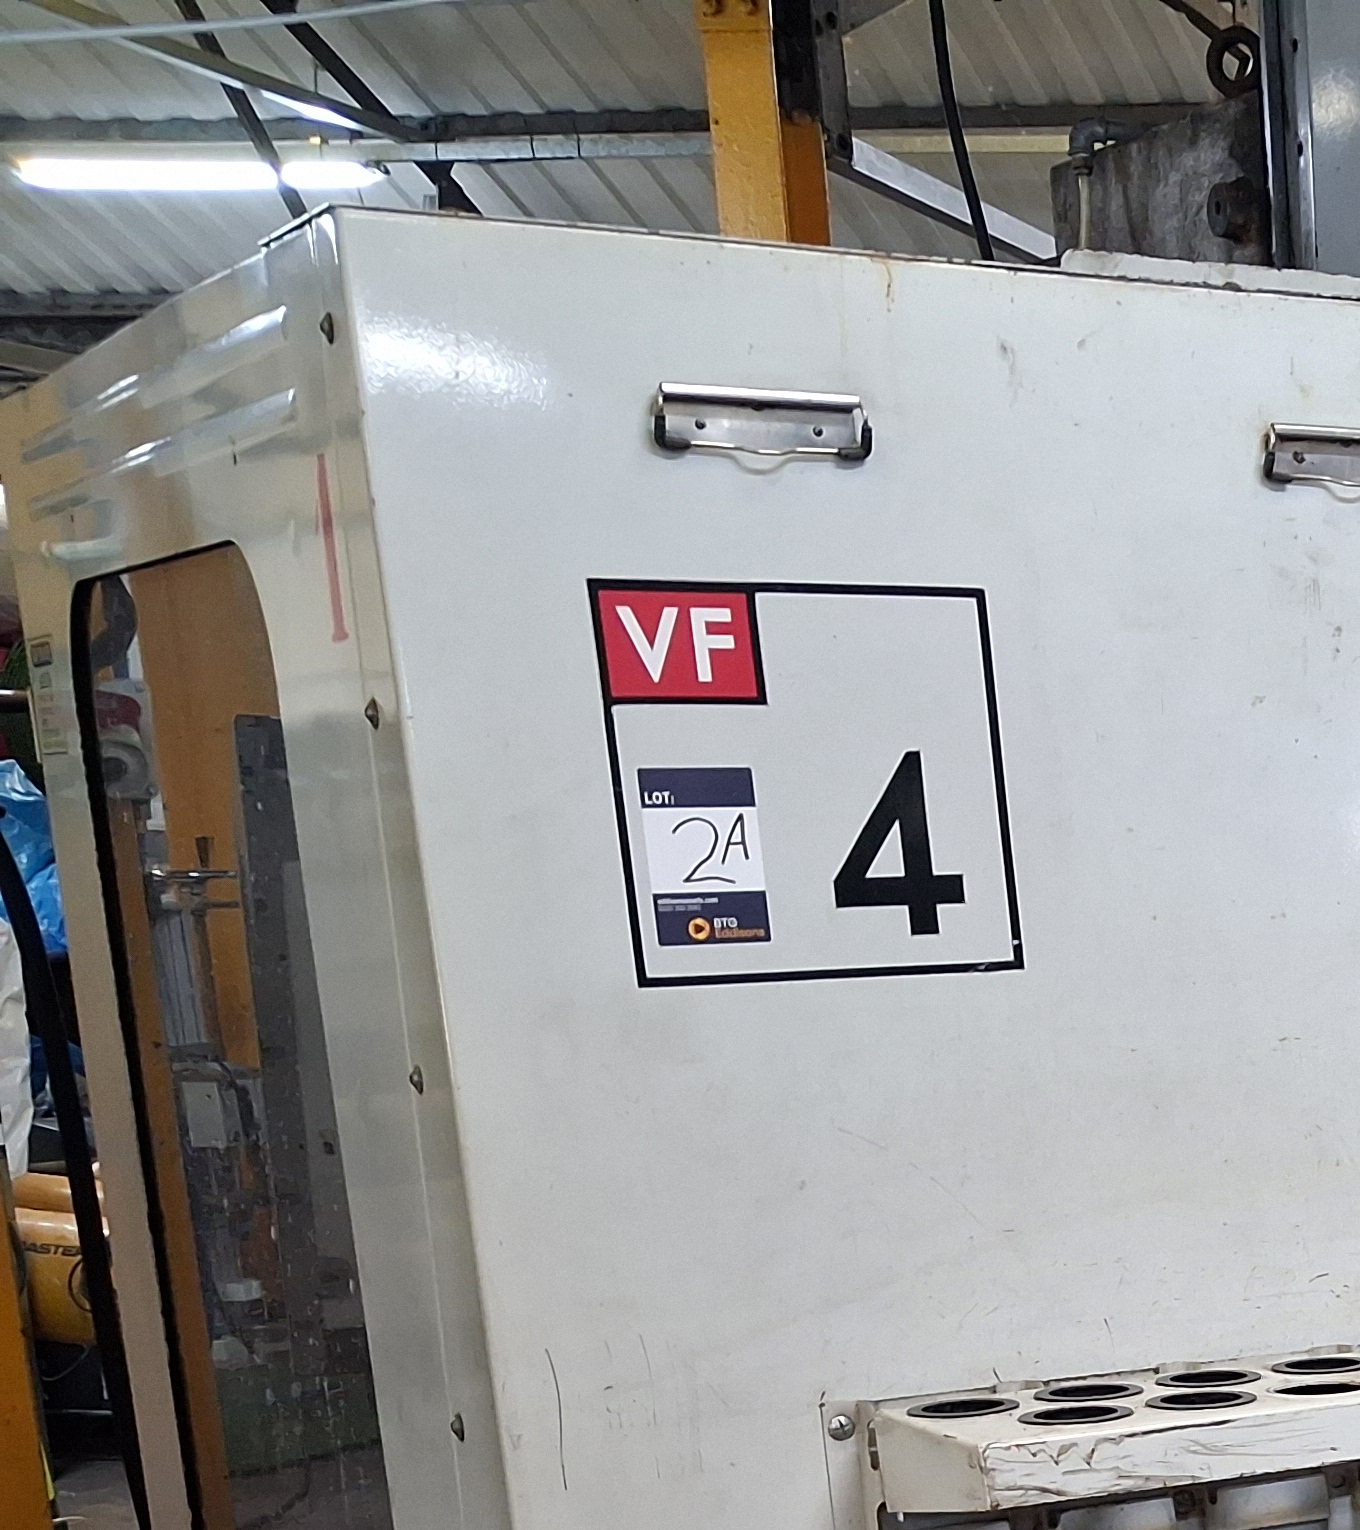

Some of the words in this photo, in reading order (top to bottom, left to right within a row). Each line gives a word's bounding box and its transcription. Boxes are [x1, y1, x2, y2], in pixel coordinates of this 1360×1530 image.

[615, 606, 735, 683] VF
[671, 812, 751, 885] 2A
[832, 750, 966, 936] 4
